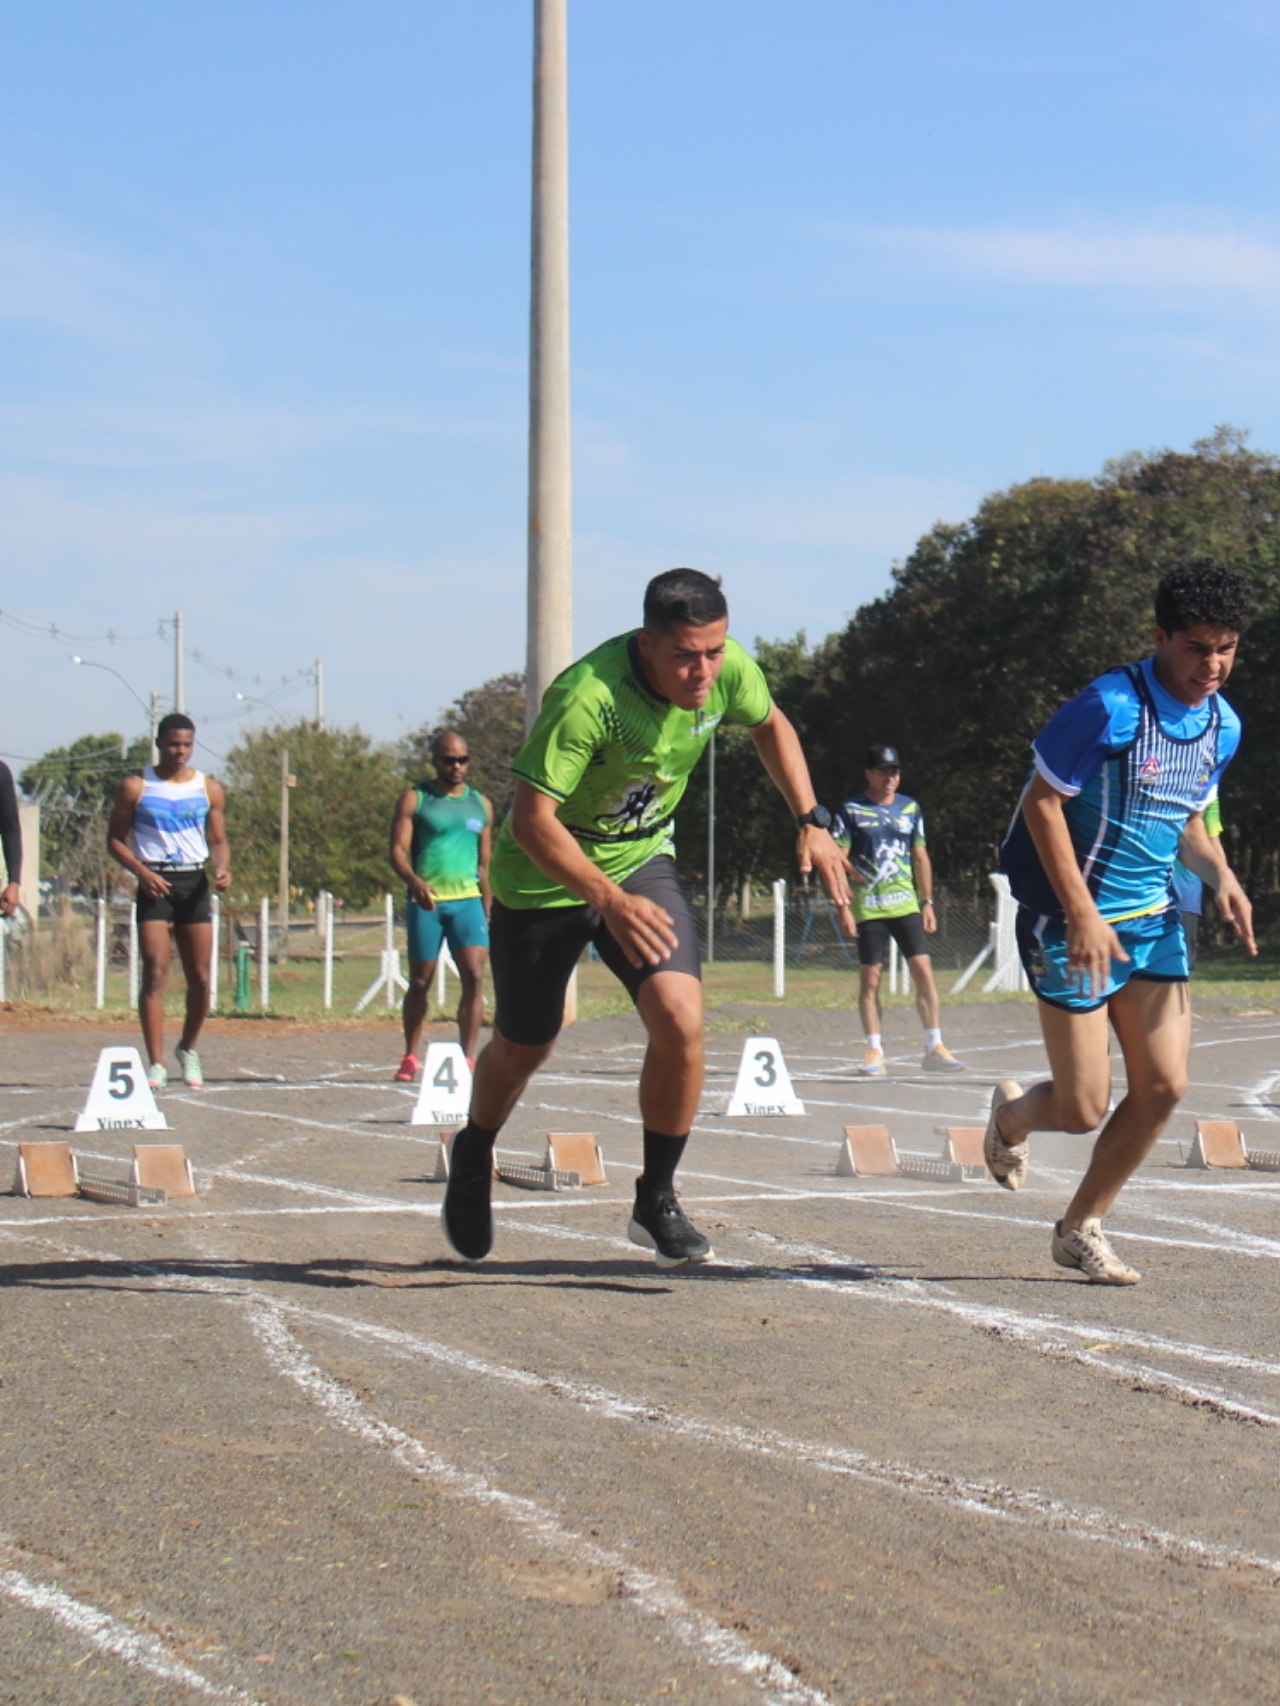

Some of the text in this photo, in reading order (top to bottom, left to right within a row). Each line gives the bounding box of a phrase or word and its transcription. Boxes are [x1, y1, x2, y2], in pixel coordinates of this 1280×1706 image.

[108, 1061, 135, 1100] 5
[433, 1056, 458, 1095] 4
[754, 1050, 777, 1088] 3
[97, 1116, 145, 1130] Vinex
[743, 1102, 786, 1115] Vinex
